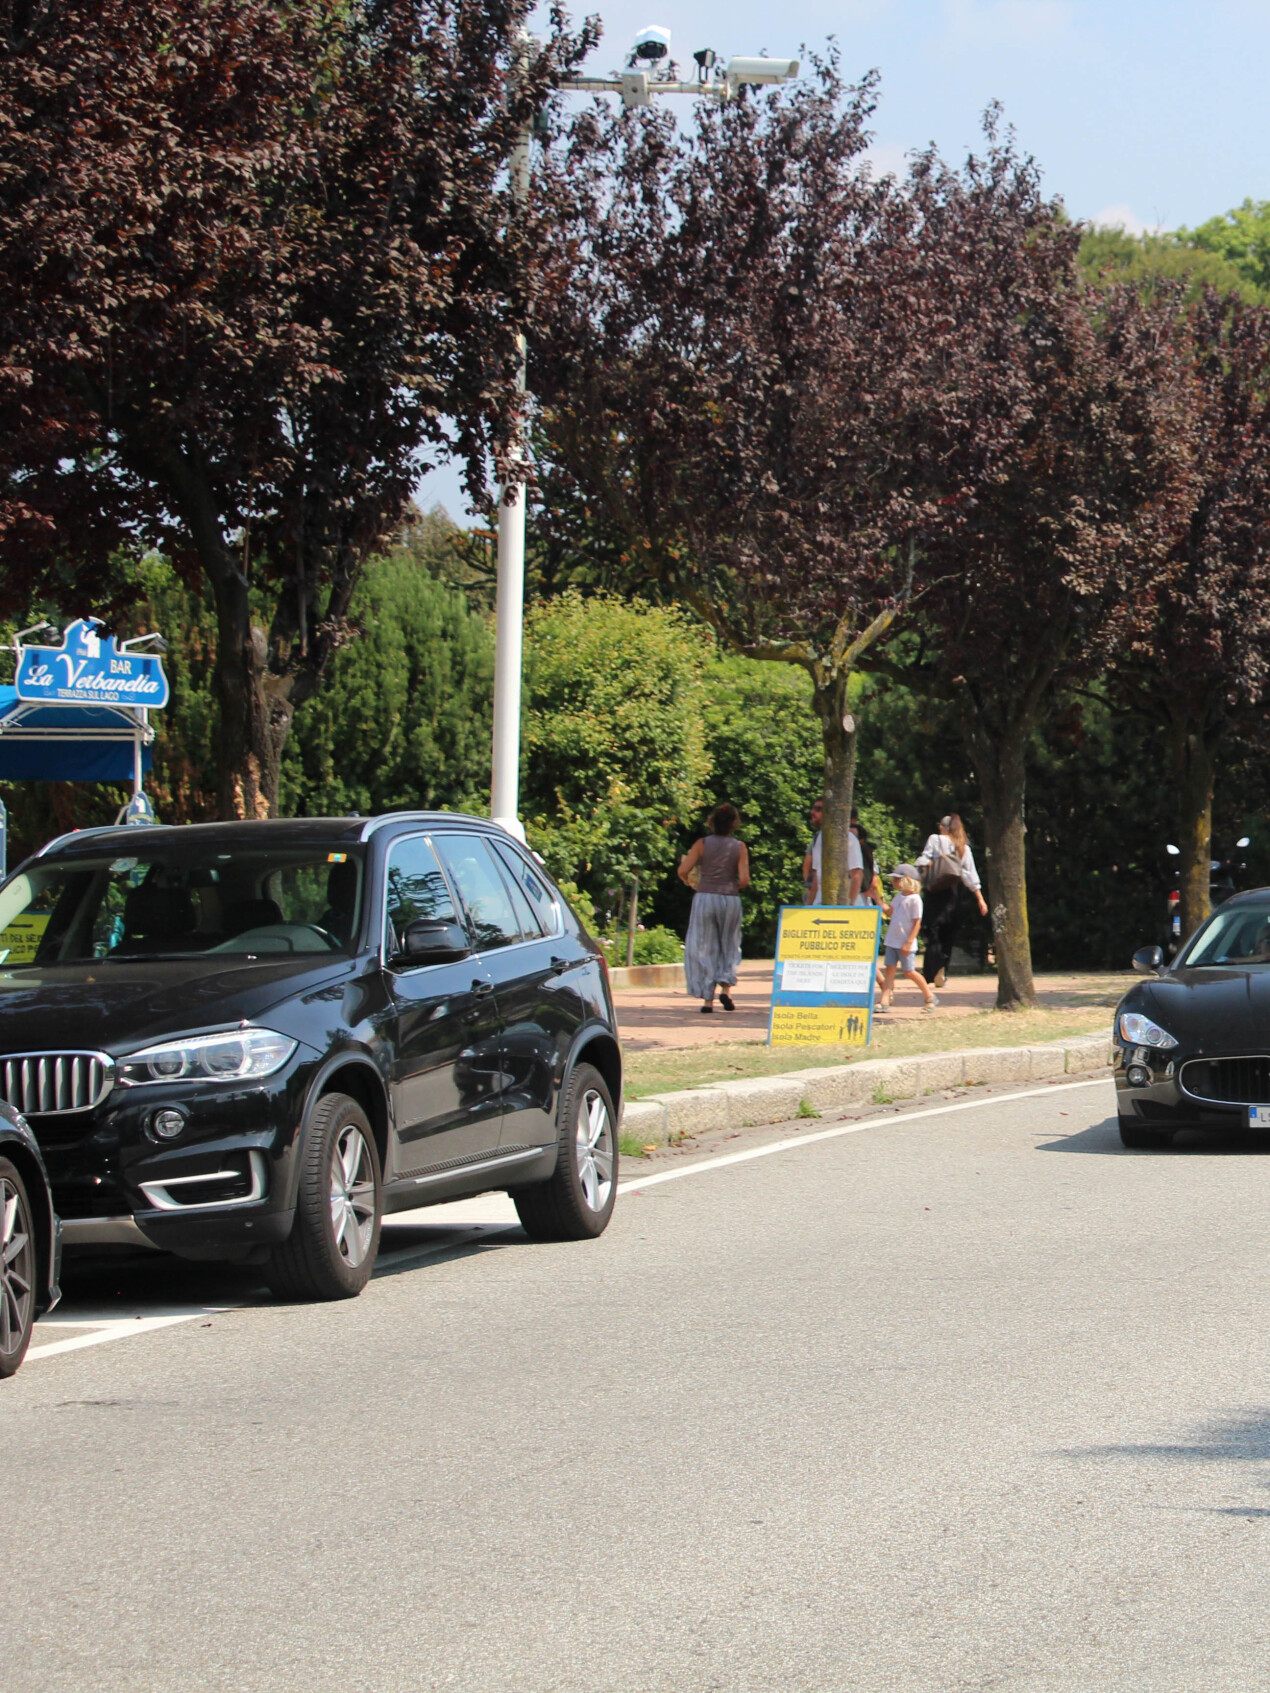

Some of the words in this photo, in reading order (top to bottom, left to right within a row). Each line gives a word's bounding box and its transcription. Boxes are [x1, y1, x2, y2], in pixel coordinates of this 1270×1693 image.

[110, 659, 132, 675] BAR
[23, 664, 55, 687] La
[57, 687, 88, 699] TERRAZZA
[88, 690, 100, 700] SUL
[100, 690, 120, 701] LAGO
[782, 929, 820, 939] BIGLIETTI
[822, 929, 837, 939] DEL
[839, 930, 875, 940] SERVIZIO
[799, 941, 838, 950] PUBBLICO
[840, 941, 856, 951] PER
[796, 1012, 818, 1020] Bella
[773, 1022, 793, 1030] Isola
[795, 1022, 836, 1031] Pescatori
[772, 1032, 792, 1040] Isola
[794, 1033, 821, 1041] Madre
